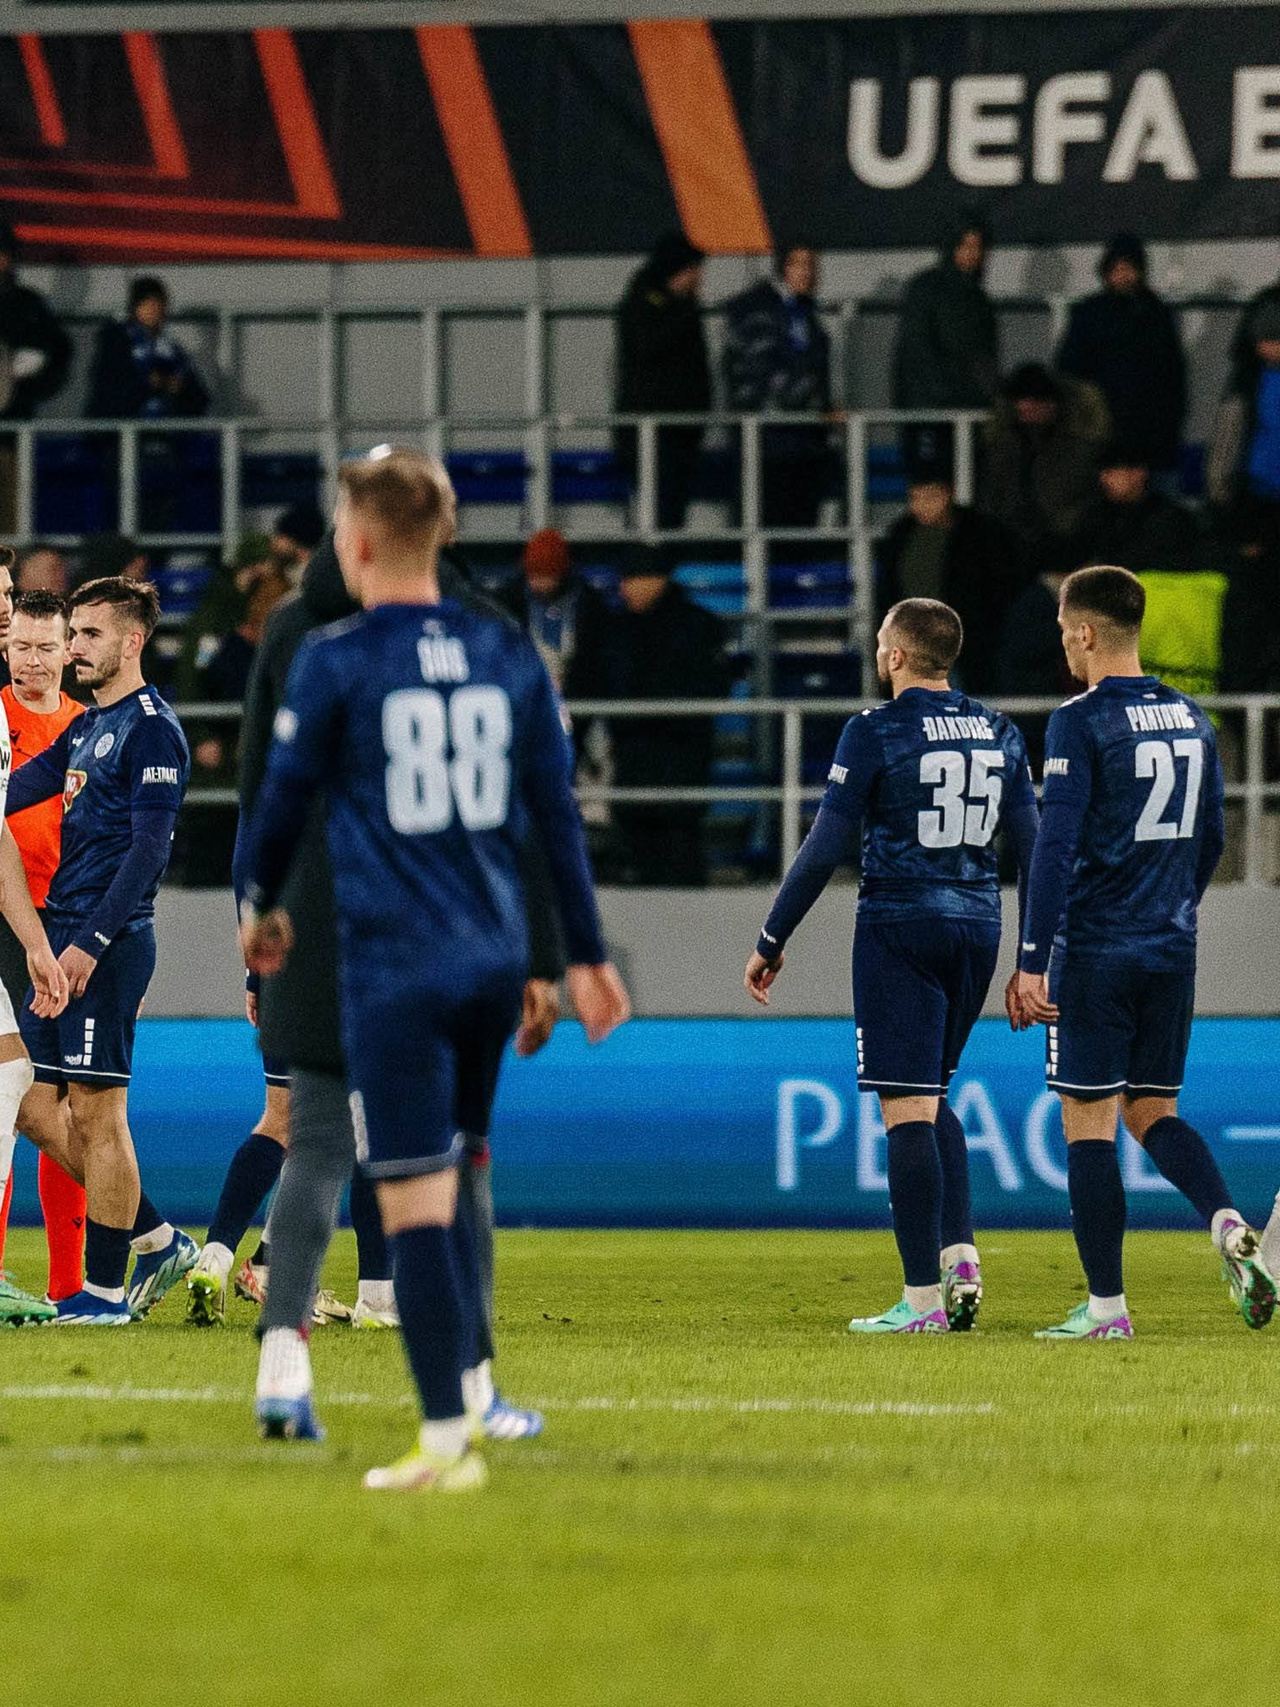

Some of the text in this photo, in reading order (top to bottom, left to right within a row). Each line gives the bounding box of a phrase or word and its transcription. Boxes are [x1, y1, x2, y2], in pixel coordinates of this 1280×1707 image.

[846, 69, 1200, 189] UEFA
[381, 684, 512, 835] 88
[918, 749, 1005, 848] 35
[1134, 739, 1204, 842] 27
